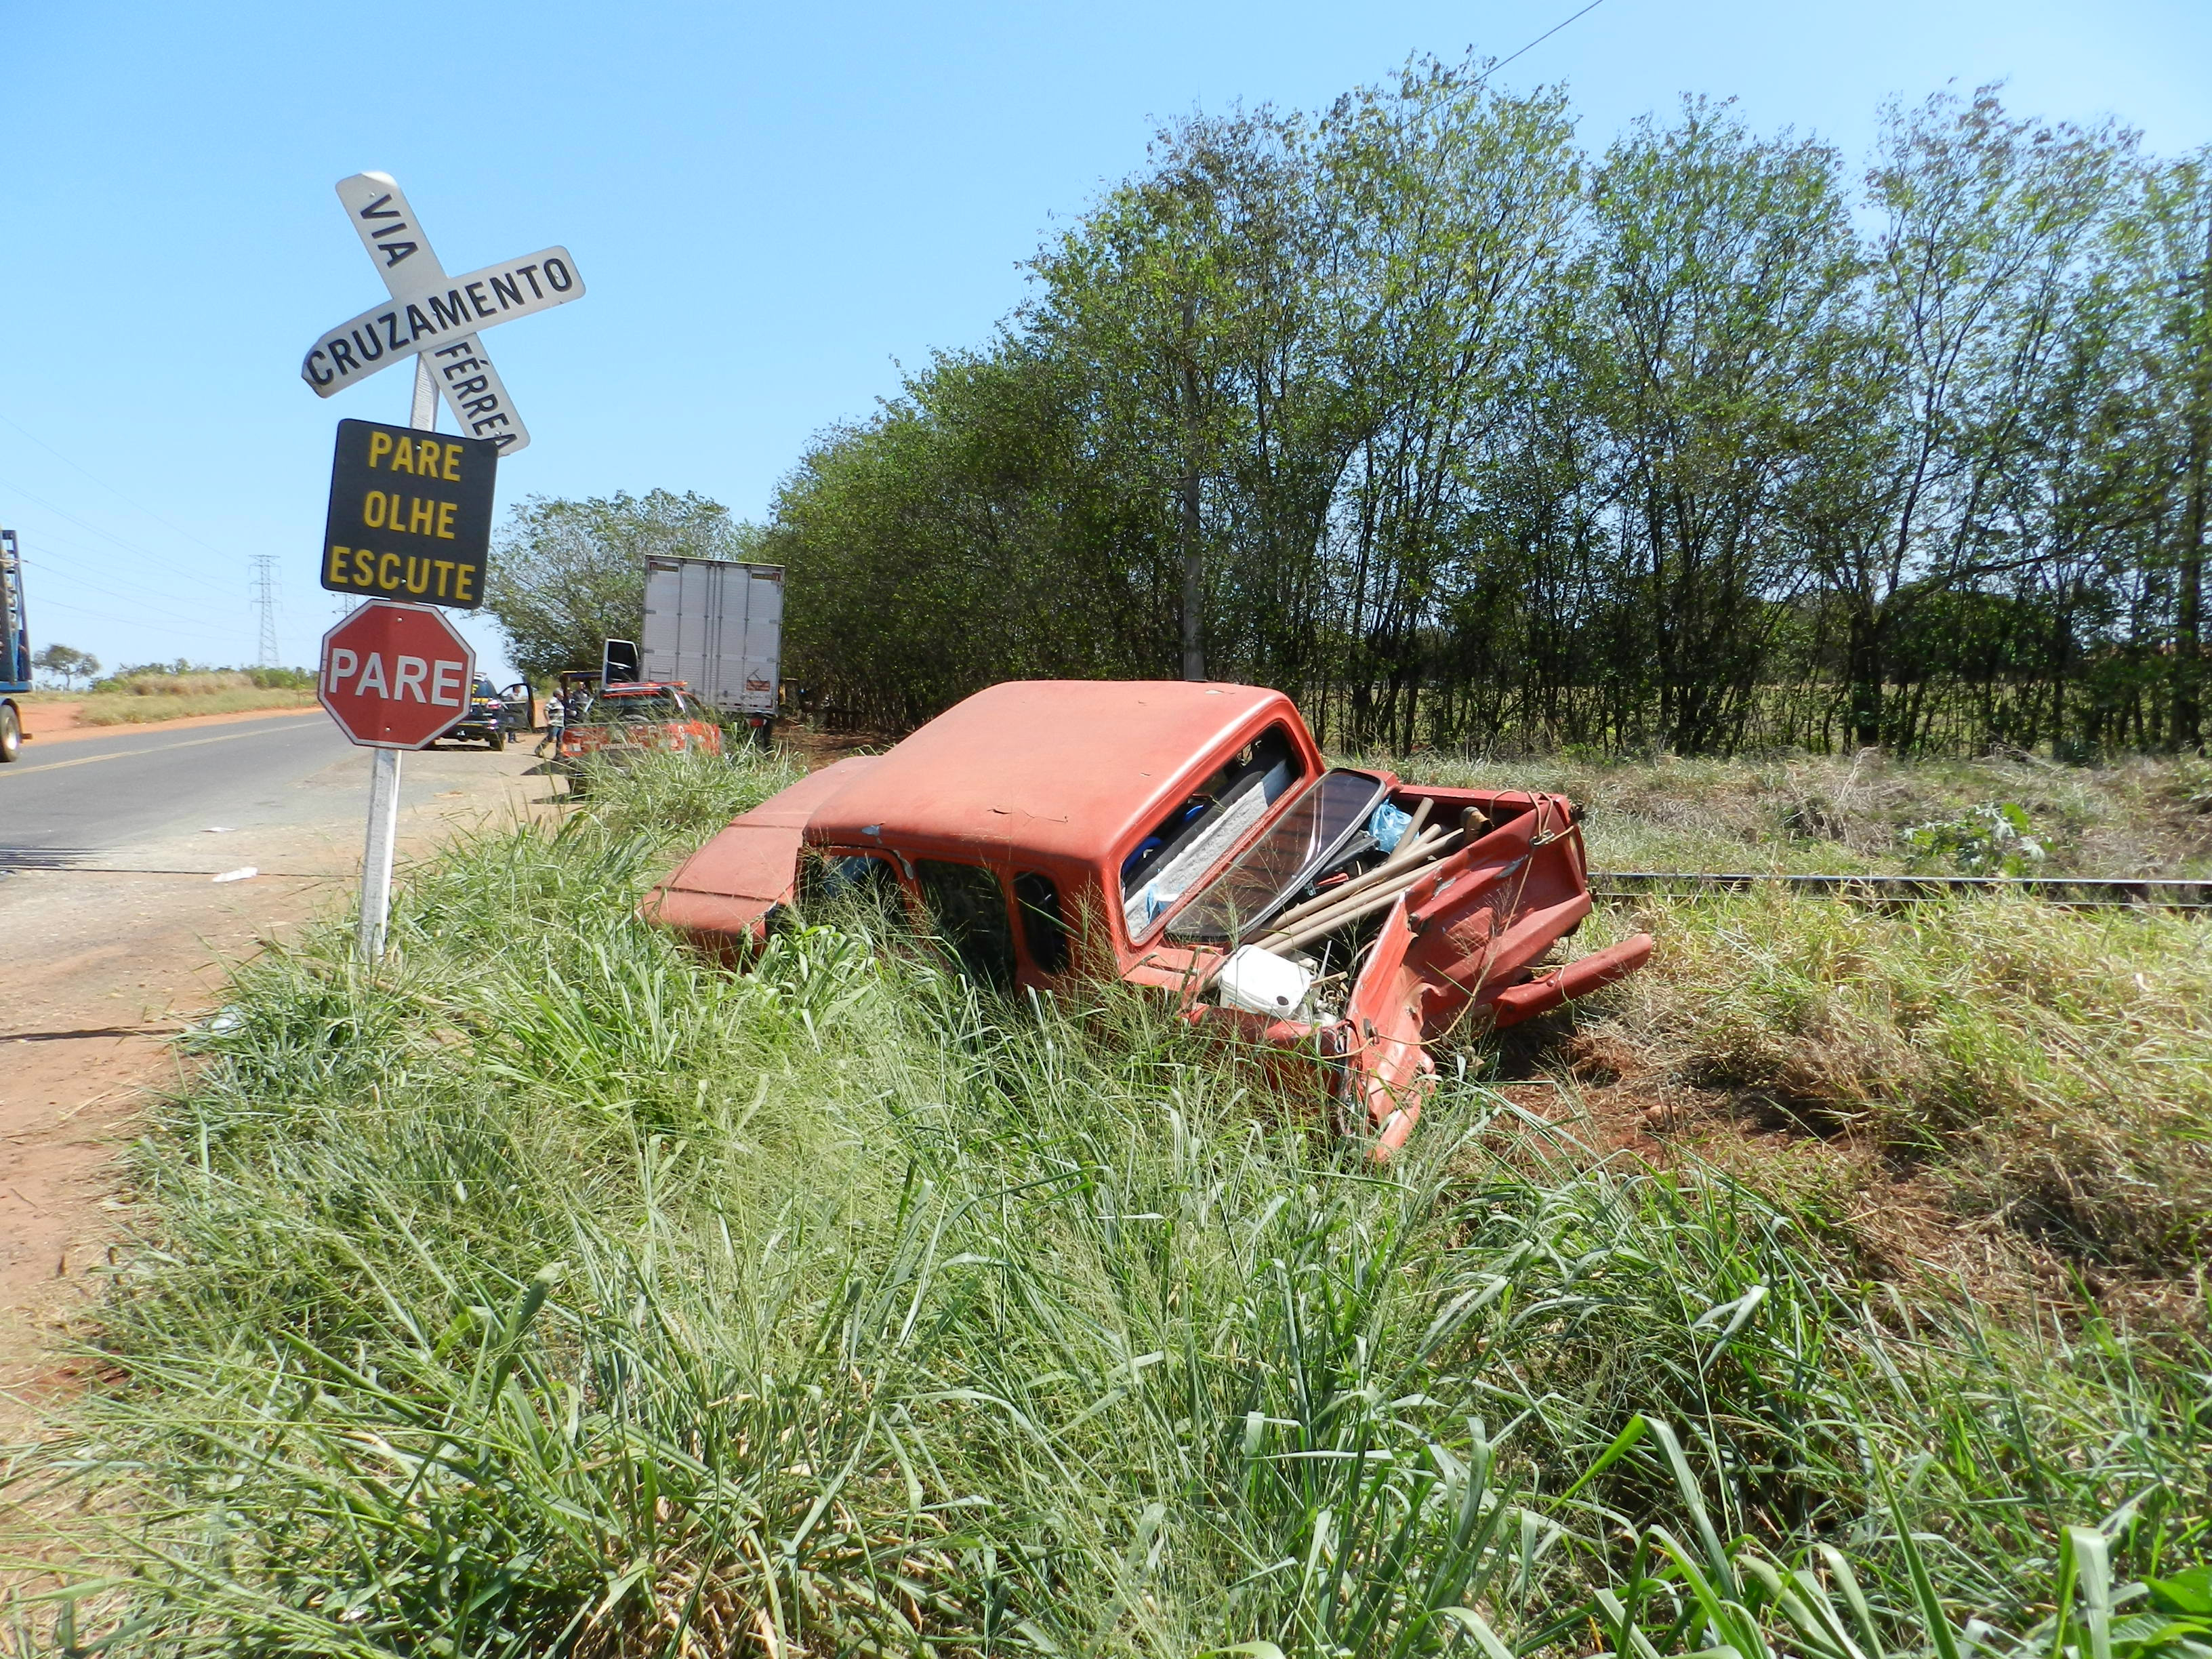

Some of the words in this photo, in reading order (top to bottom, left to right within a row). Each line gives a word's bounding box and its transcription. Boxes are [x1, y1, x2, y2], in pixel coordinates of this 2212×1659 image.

[361, 194, 419, 268] VIA
[307, 258, 573, 386] CRUZAMENTO
[370, 432, 464, 482] PARE
[364, 491, 457, 539] OLHE
[329, 545, 476, 601] ESCUTE
[329, 648, 463, 708] PARE
